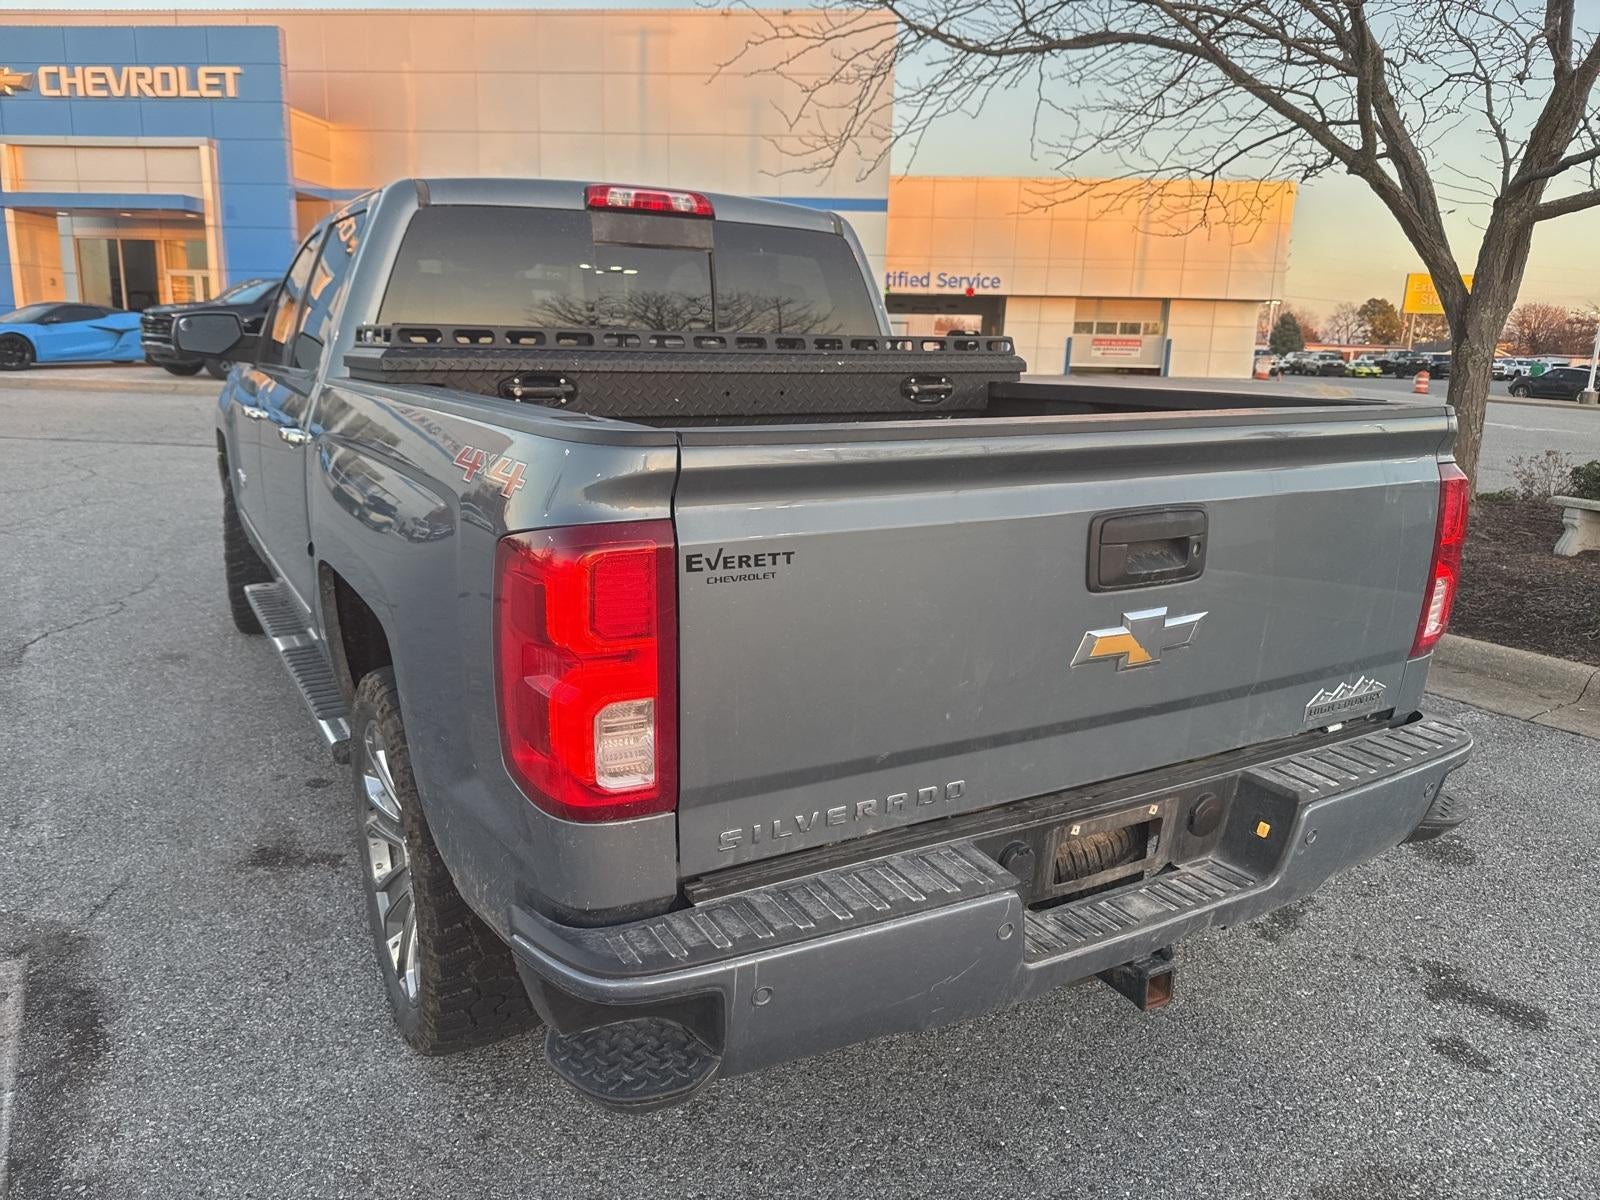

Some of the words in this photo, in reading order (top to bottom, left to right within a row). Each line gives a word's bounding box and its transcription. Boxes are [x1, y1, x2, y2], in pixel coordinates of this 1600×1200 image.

[37, 65, 243, 98] CHEVROLET
[937, 272, 1001, 289] Service
[685, 547, 796, 573] EVERETT
[706, 571, 776, 585] CHEVROLET
[1308, 704, 1335, 716] HIGH
[717, 779, 967, 852] SILVERADO
